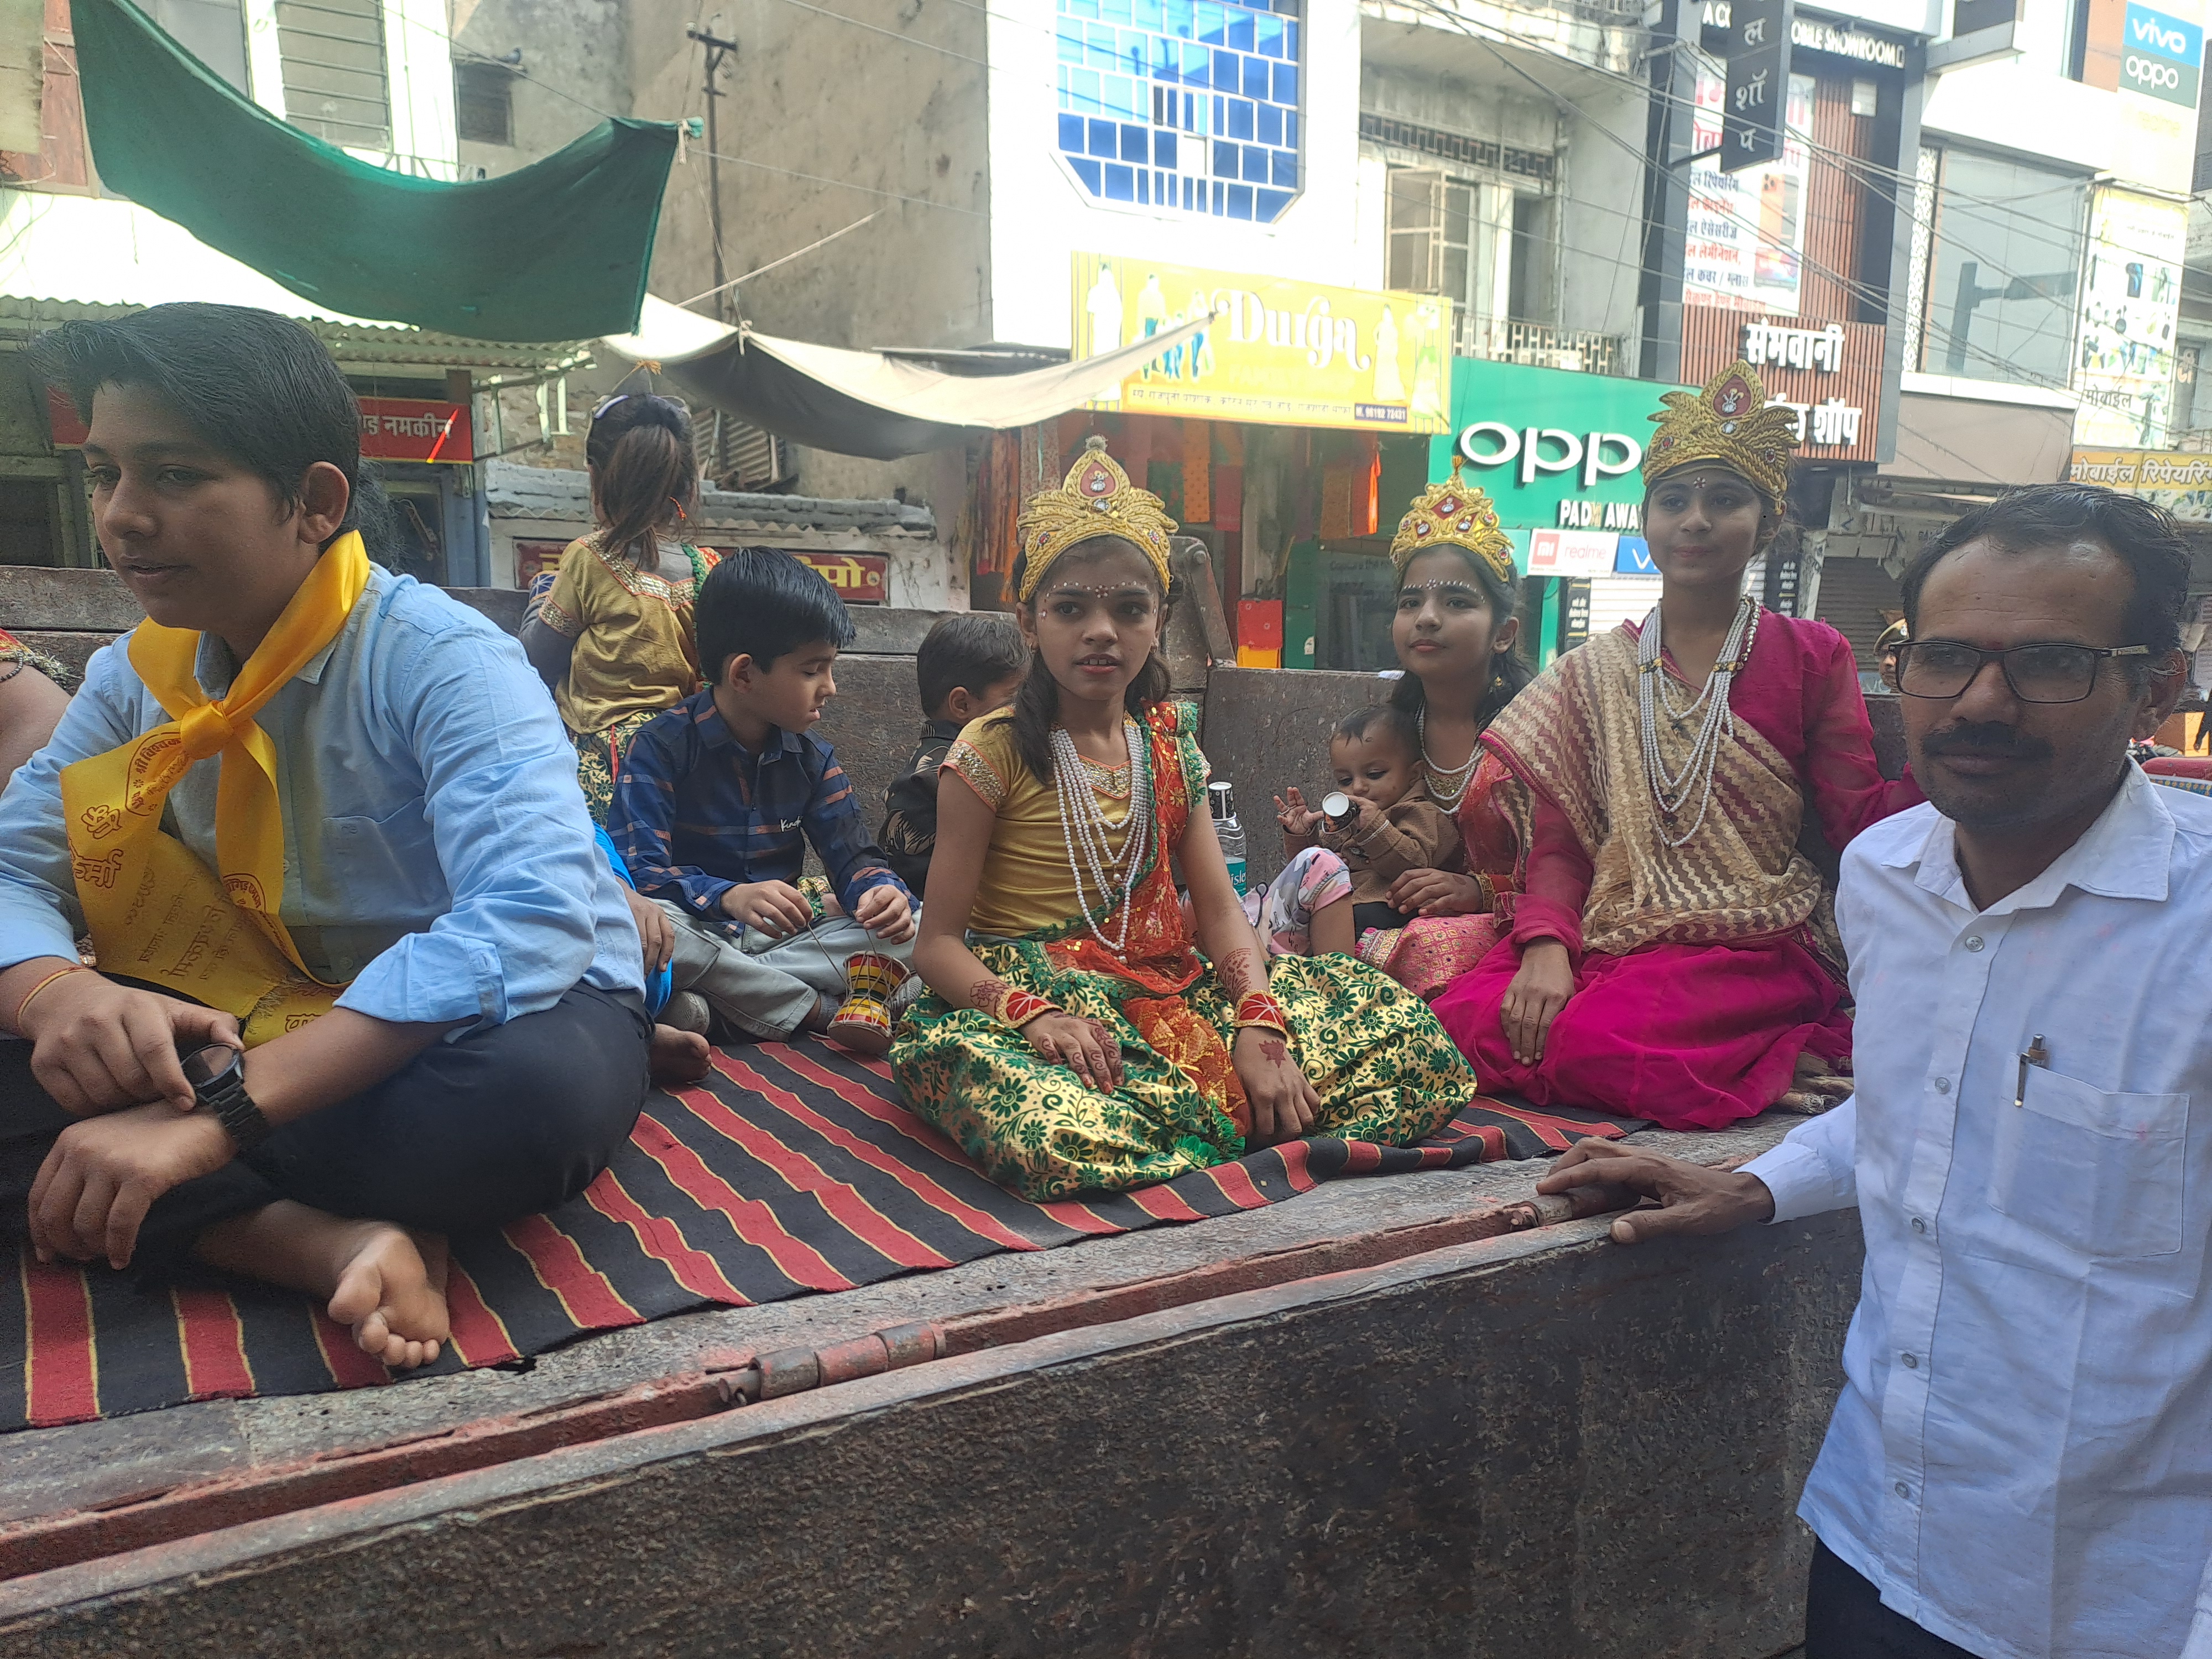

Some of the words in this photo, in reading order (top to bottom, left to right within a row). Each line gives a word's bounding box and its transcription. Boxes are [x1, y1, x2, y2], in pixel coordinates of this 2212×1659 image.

[1791, 20, 1822, 50] OBILE
[1824, 27, 1896, 67] SHOWROOM
[2132, 18, 2186, 54] vivo
[2126, 55, 2179, 90] oppo
[1210, 287, 1371, 372] Durga
[2084, 383, 2132, 409] मोबाईल
[1814, 396, 1863, 446] शॉप
[1460, 421, 1643, 486] opp
[2070, 456, 2138, 486] मोबाईल
[1564, 545, 1606, 560] realme
[1230, 869, 1246, 885] isle
